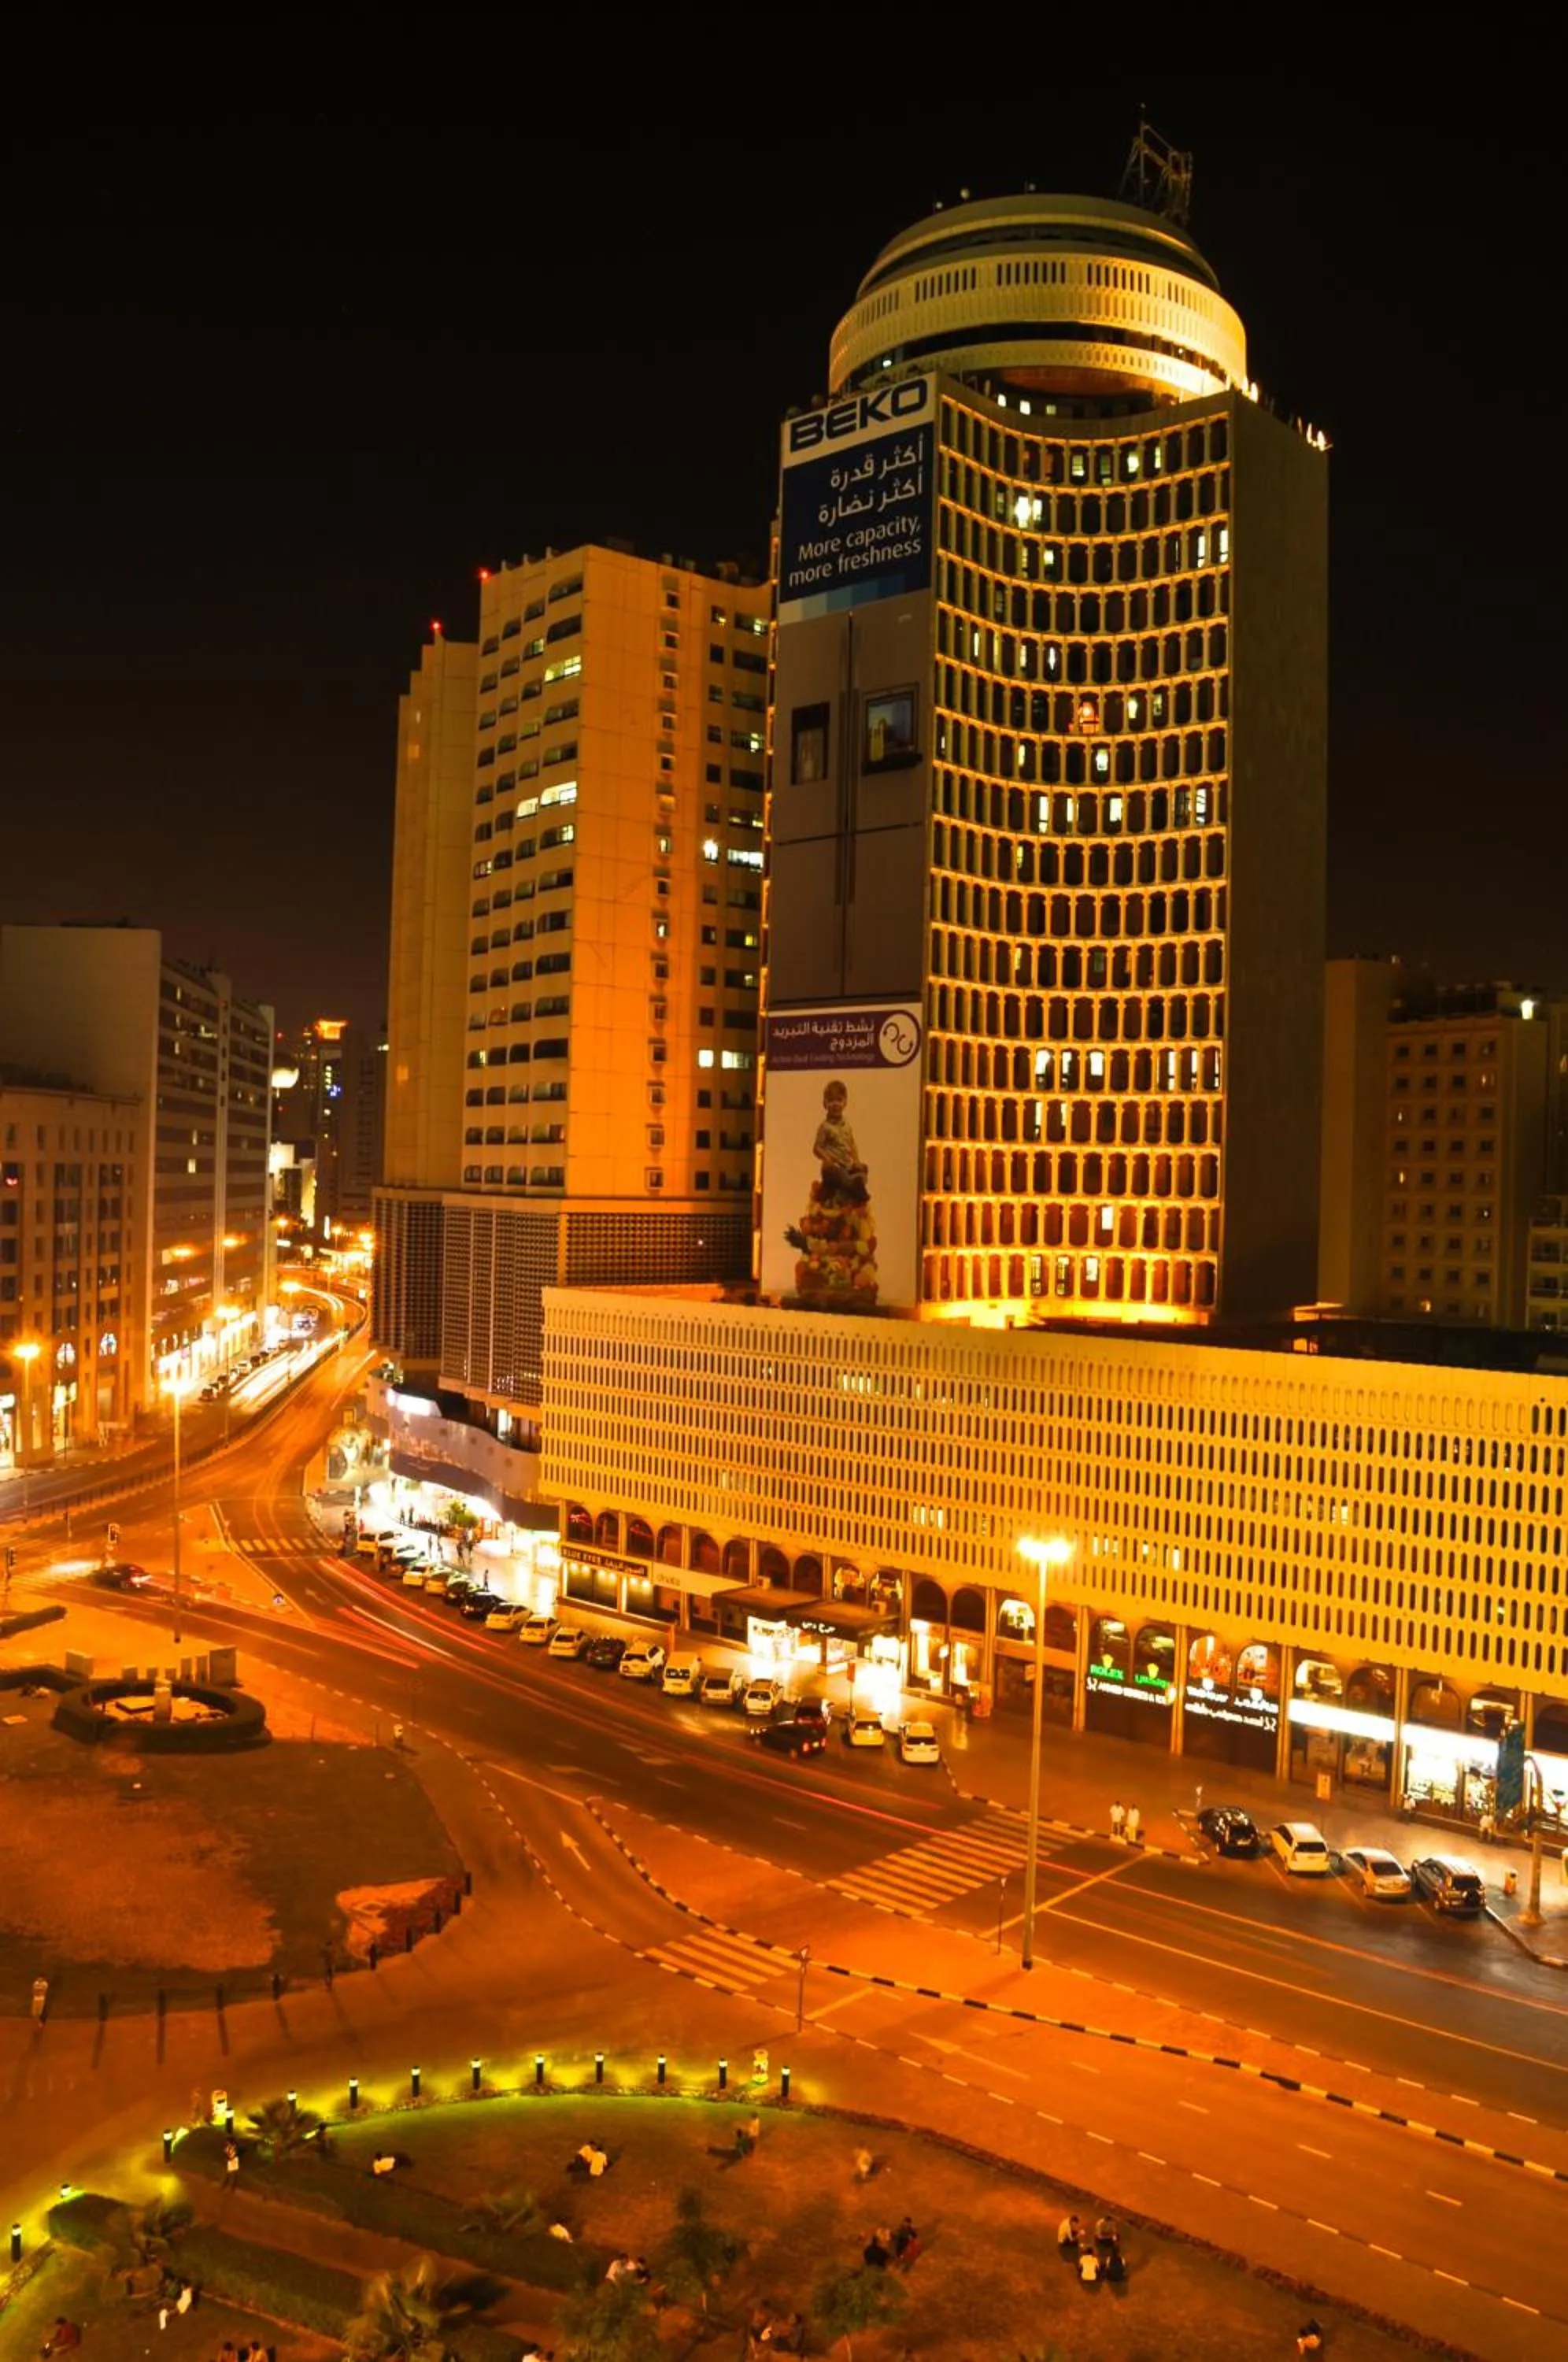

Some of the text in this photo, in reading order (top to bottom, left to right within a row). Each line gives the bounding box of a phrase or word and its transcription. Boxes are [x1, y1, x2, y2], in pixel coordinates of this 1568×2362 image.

[790, 378, 927, 452] BEKO
[830, 432, 923, 491] أكثر قدرة
[818, 467, 923, 527] أكثر نضارة
[789, 539, 921, 587] more freshness
[798, 516, 921, 562] More capacity,
[1090, 1664, 1124, 1681] ROLEX
